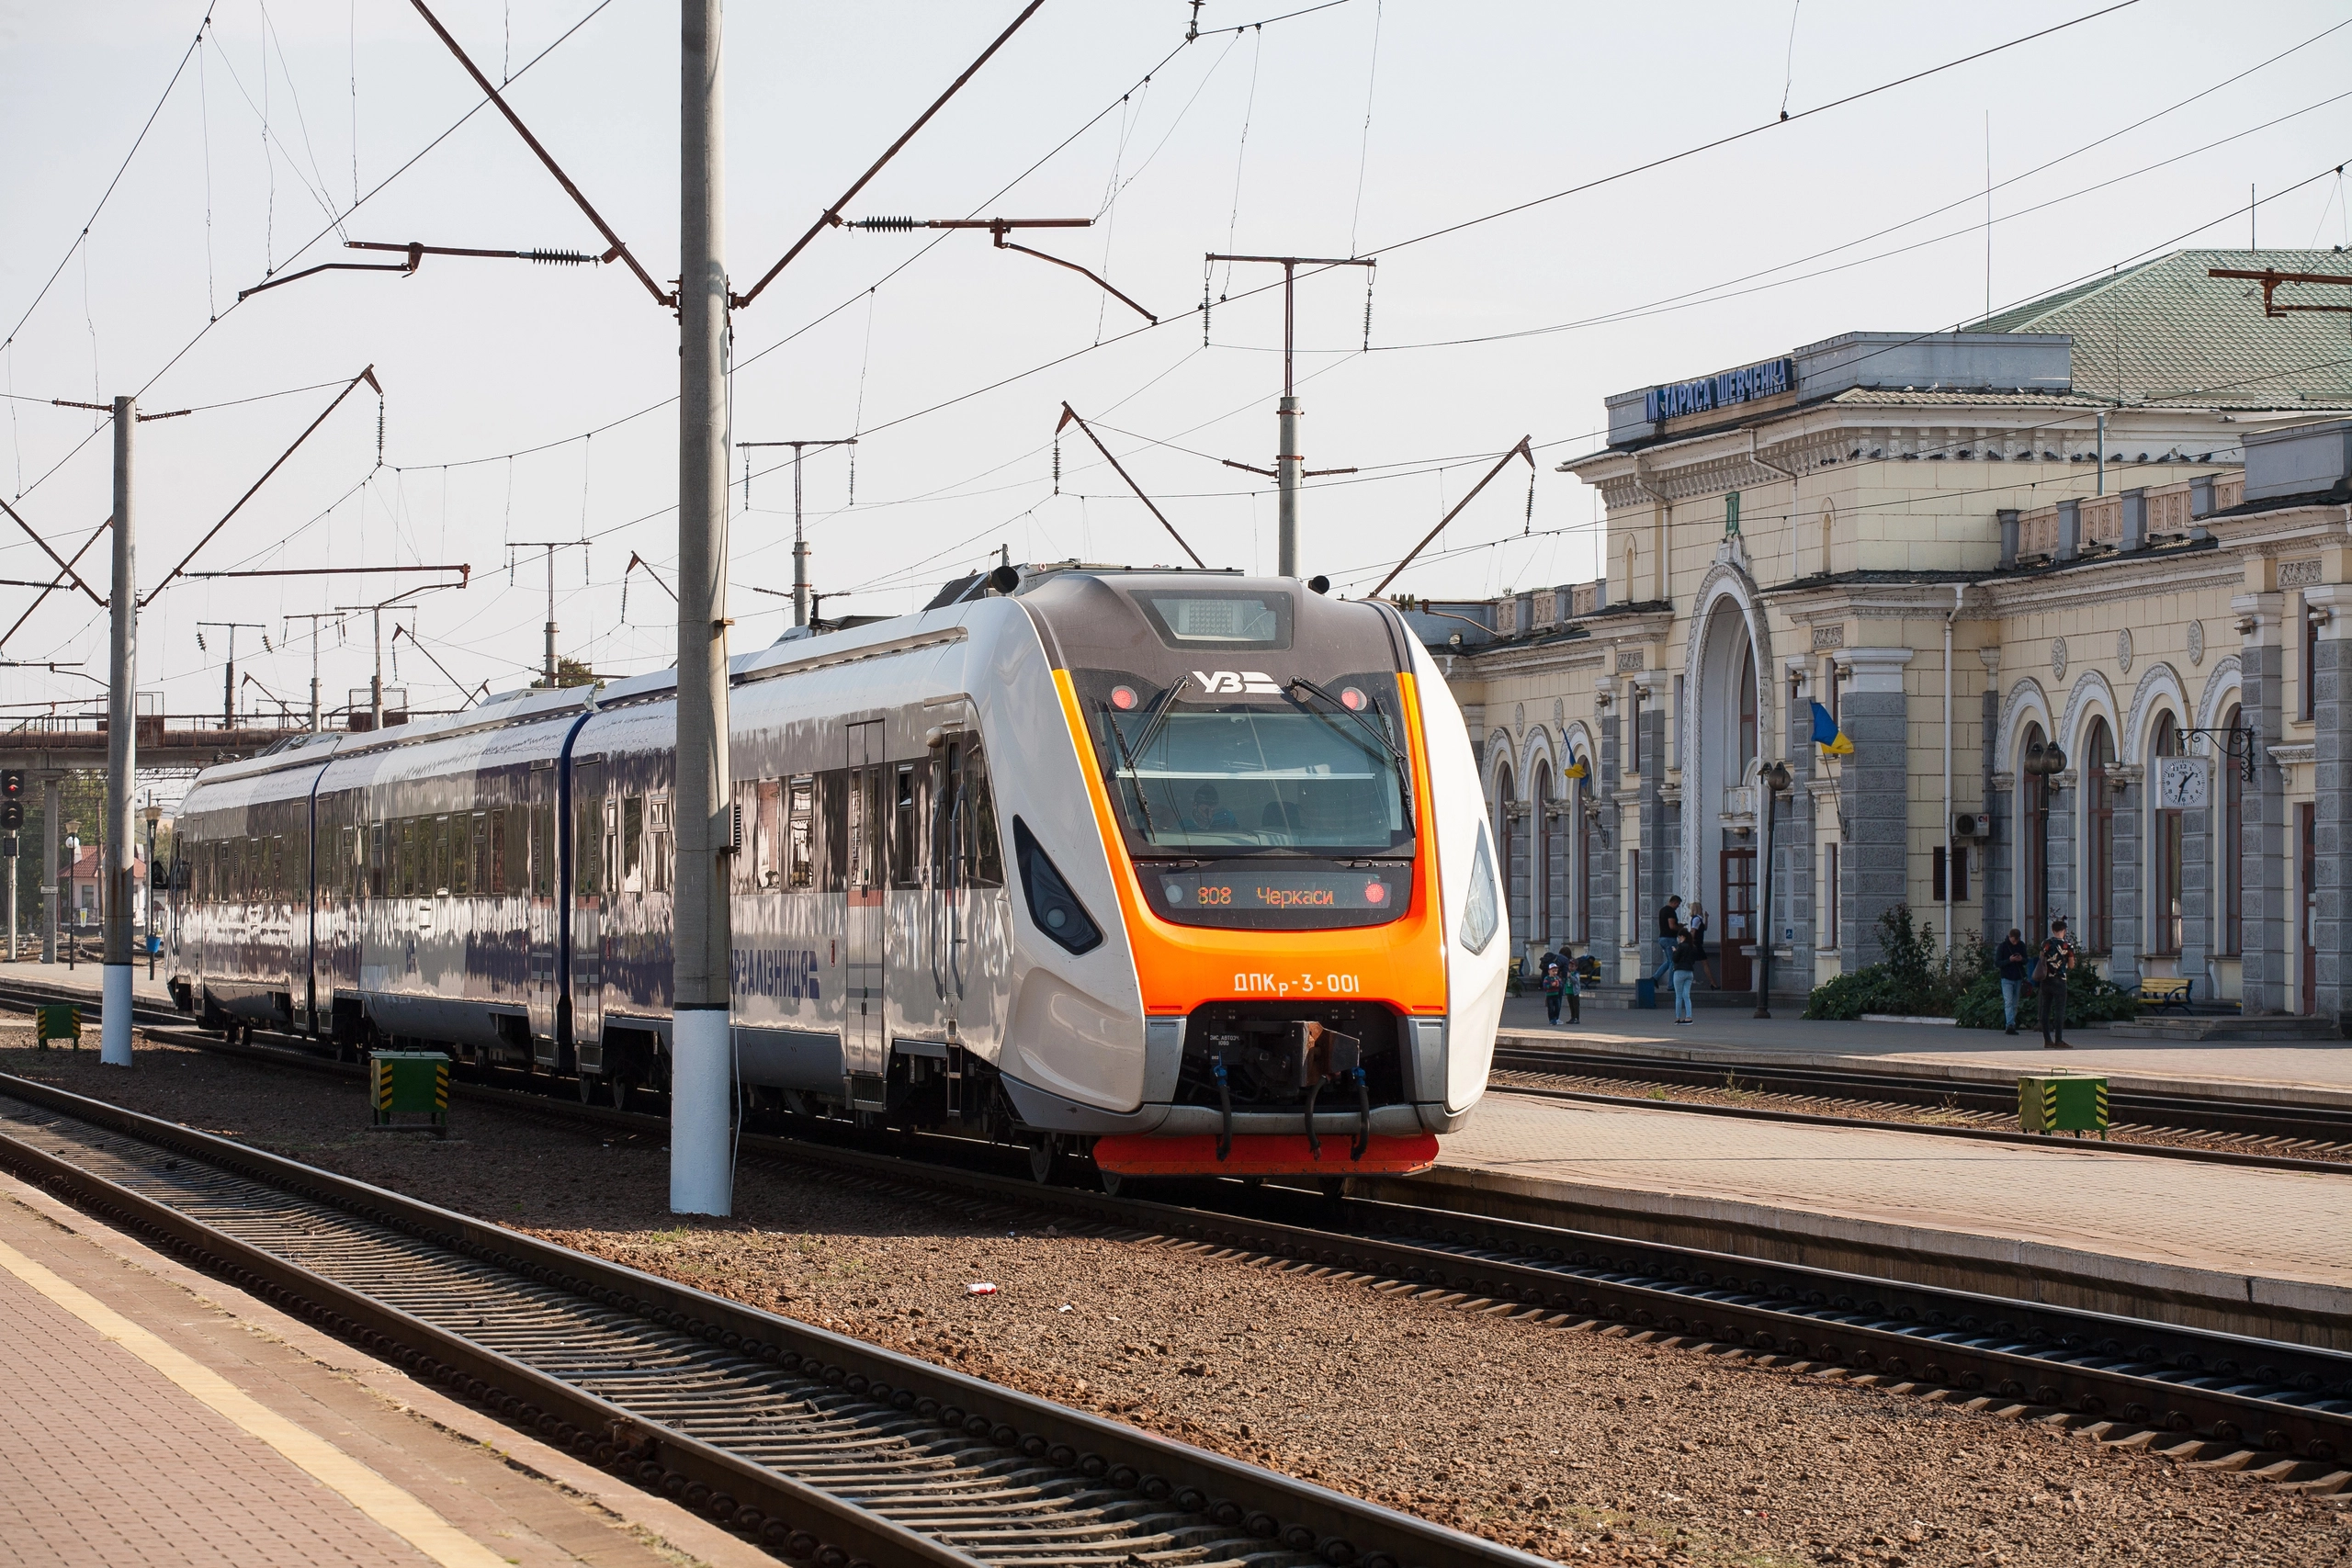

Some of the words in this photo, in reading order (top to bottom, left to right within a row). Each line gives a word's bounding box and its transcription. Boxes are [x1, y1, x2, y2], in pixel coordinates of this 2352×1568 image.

[1664, 379, 1713, 419] ТАРАСА
[1717, 358, 1788, 407] ШЕВЧЕНКА
[1197, 886, 1232, 905] 808
[1256, 886, 1334, 909] Черкаси
[729, 949, 808, 1006] РЗАЛІЗНИЦЯ
